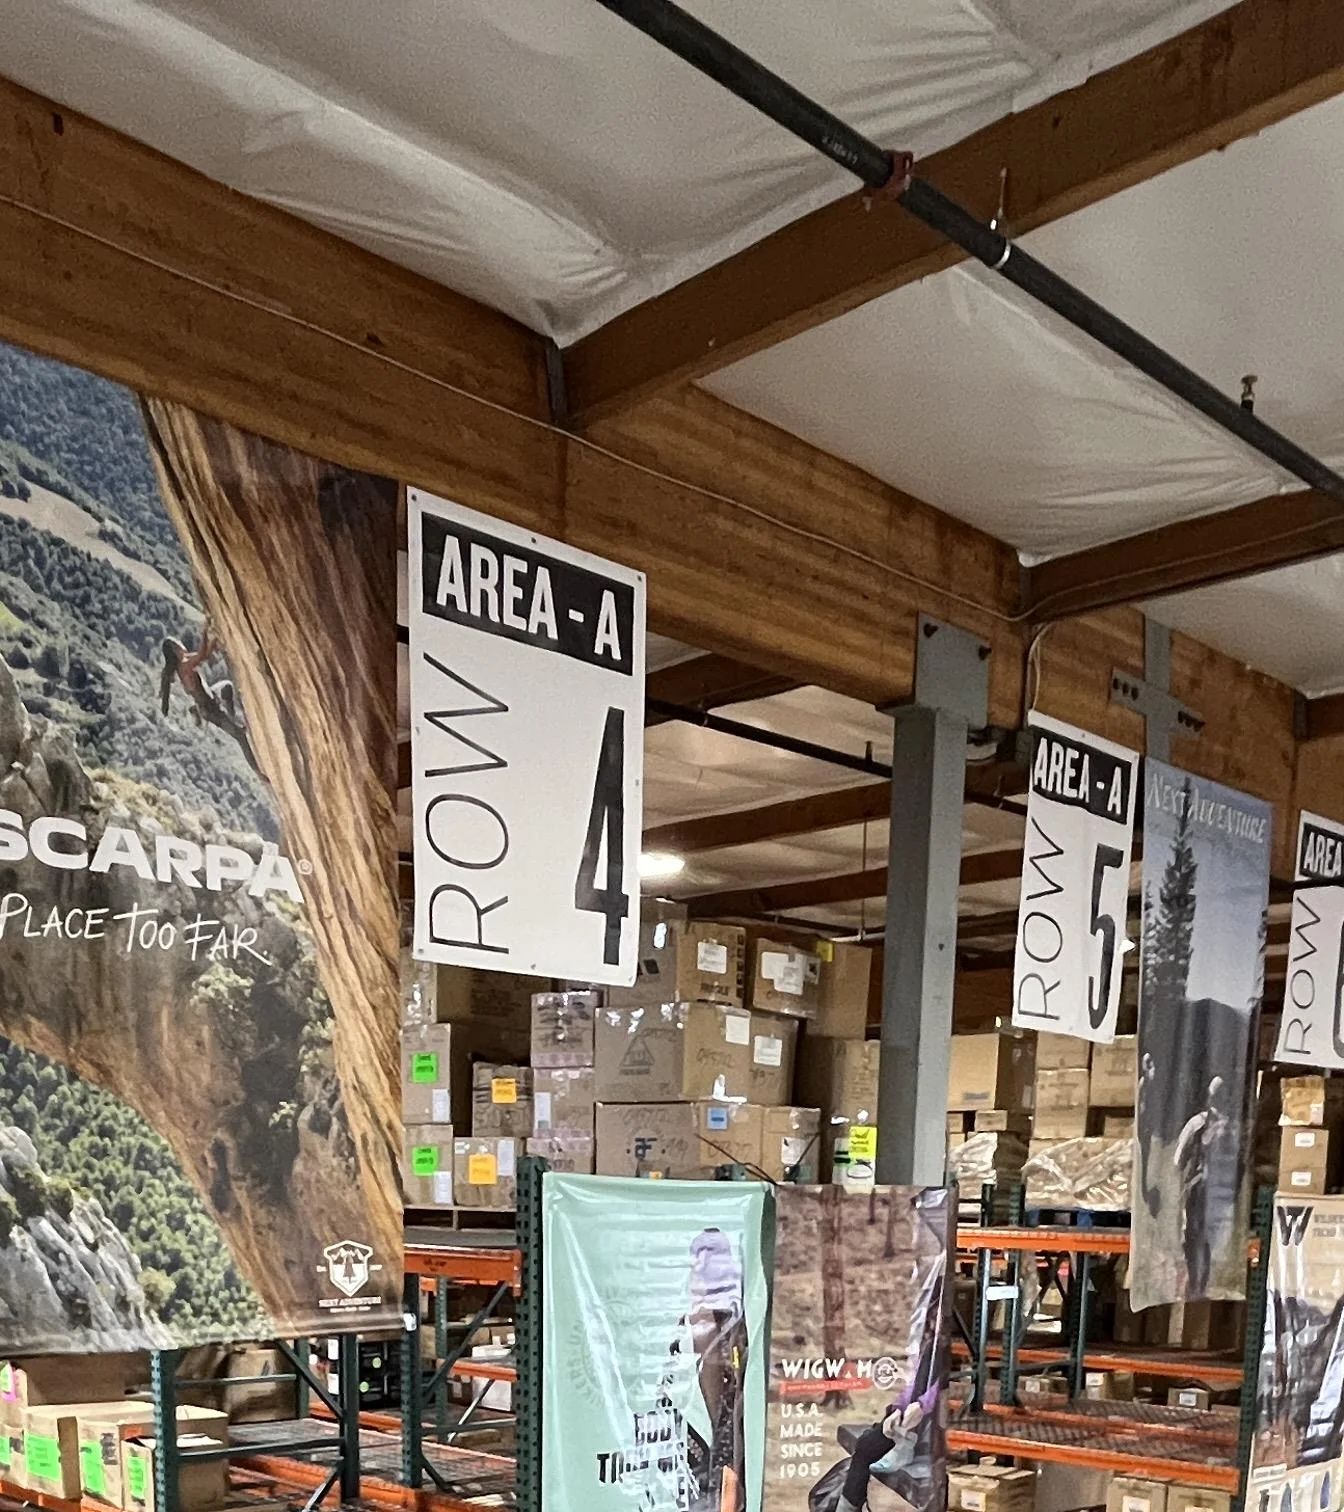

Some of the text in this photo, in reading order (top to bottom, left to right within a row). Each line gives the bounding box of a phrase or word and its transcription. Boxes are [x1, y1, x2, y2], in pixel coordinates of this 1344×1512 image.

[436, 533, 558, 642] AREA
[593, 588, 624, 661] A
[425, 652, 509, 956] ROW
[1032, 737, 1090, 803] AREA
[1108, 765, 1123, 816] A
[1147, 773, 1266, 843] NEXT ADVENTURE
[575, 707, 629, 966] 4
[1304, 832, 1342, 875] AREA
[1019, 816, 1065, 1022] ROW
[1087, 843, 1124, 1029] 5
[1284, 896, 1321, 1056] ROW
[780, 1422, 823, 1438] MADE
[780, 1462, 820, 1479] 1905
[781, 1442, 823, 1459] SINCE
